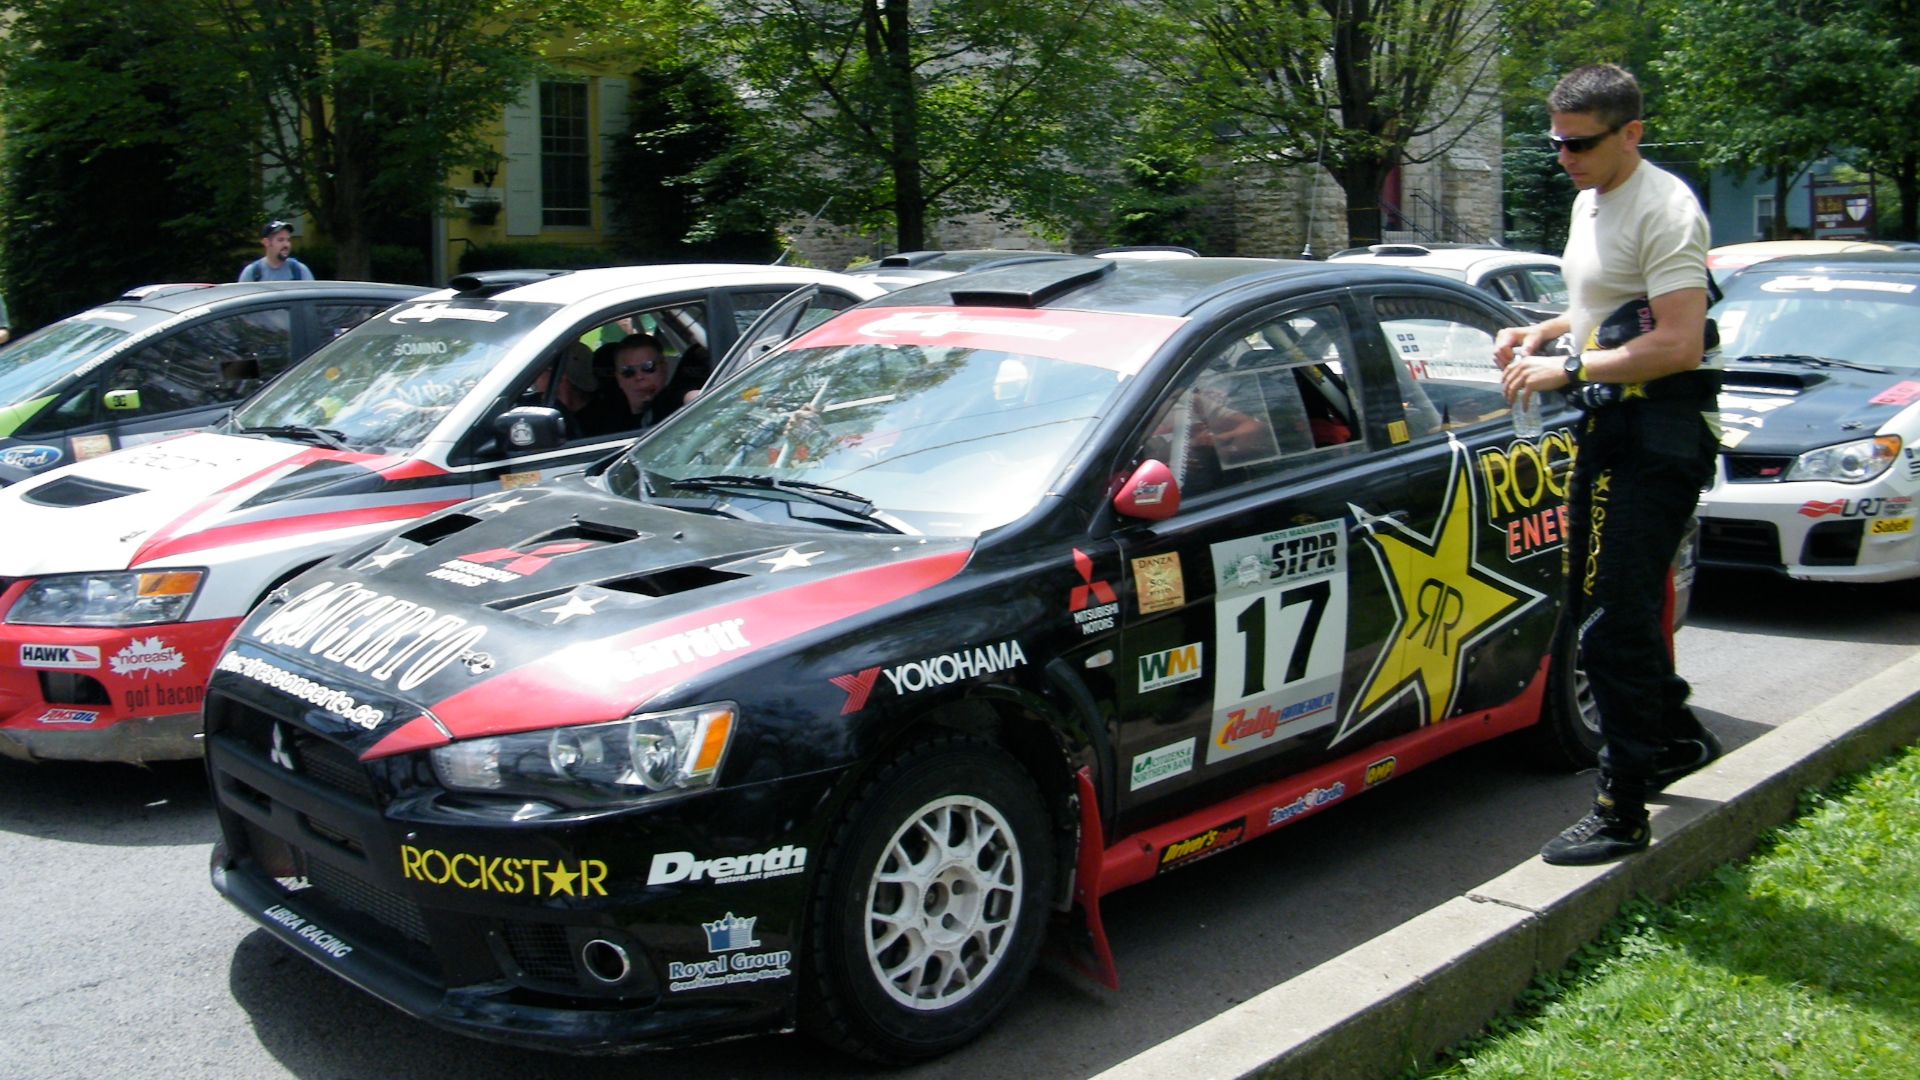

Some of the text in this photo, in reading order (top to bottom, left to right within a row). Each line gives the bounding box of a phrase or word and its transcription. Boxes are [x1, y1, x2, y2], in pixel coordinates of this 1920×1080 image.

[2, 448, 48, 467] Ford
[1138, 556, 1174, 569] DANZA
[1269, 531, 1338, 580] STPR
[1073, 602, 1120, 624] MITSUBISHI
[1081, 616, 1115, 635] MOTORS
[1237, 579, 1331, 698] 17
[22, 646, 70, 662] HAWK
[120, 649, 174, 664] noreast
[882, 639, 1028, 696] YOKOHAMA
[1140, 644, 1198, 683] WM
[125, 686, 149, 711] got
[40, 709, 98, 723] AMSOIL
[1219, 704, 1282, 745] Rally
[646, 844, 808, 886] Drenth
[263, 904, 353, 958] LIBRA RACING
[668, 949, 792, 980] Royal Group
